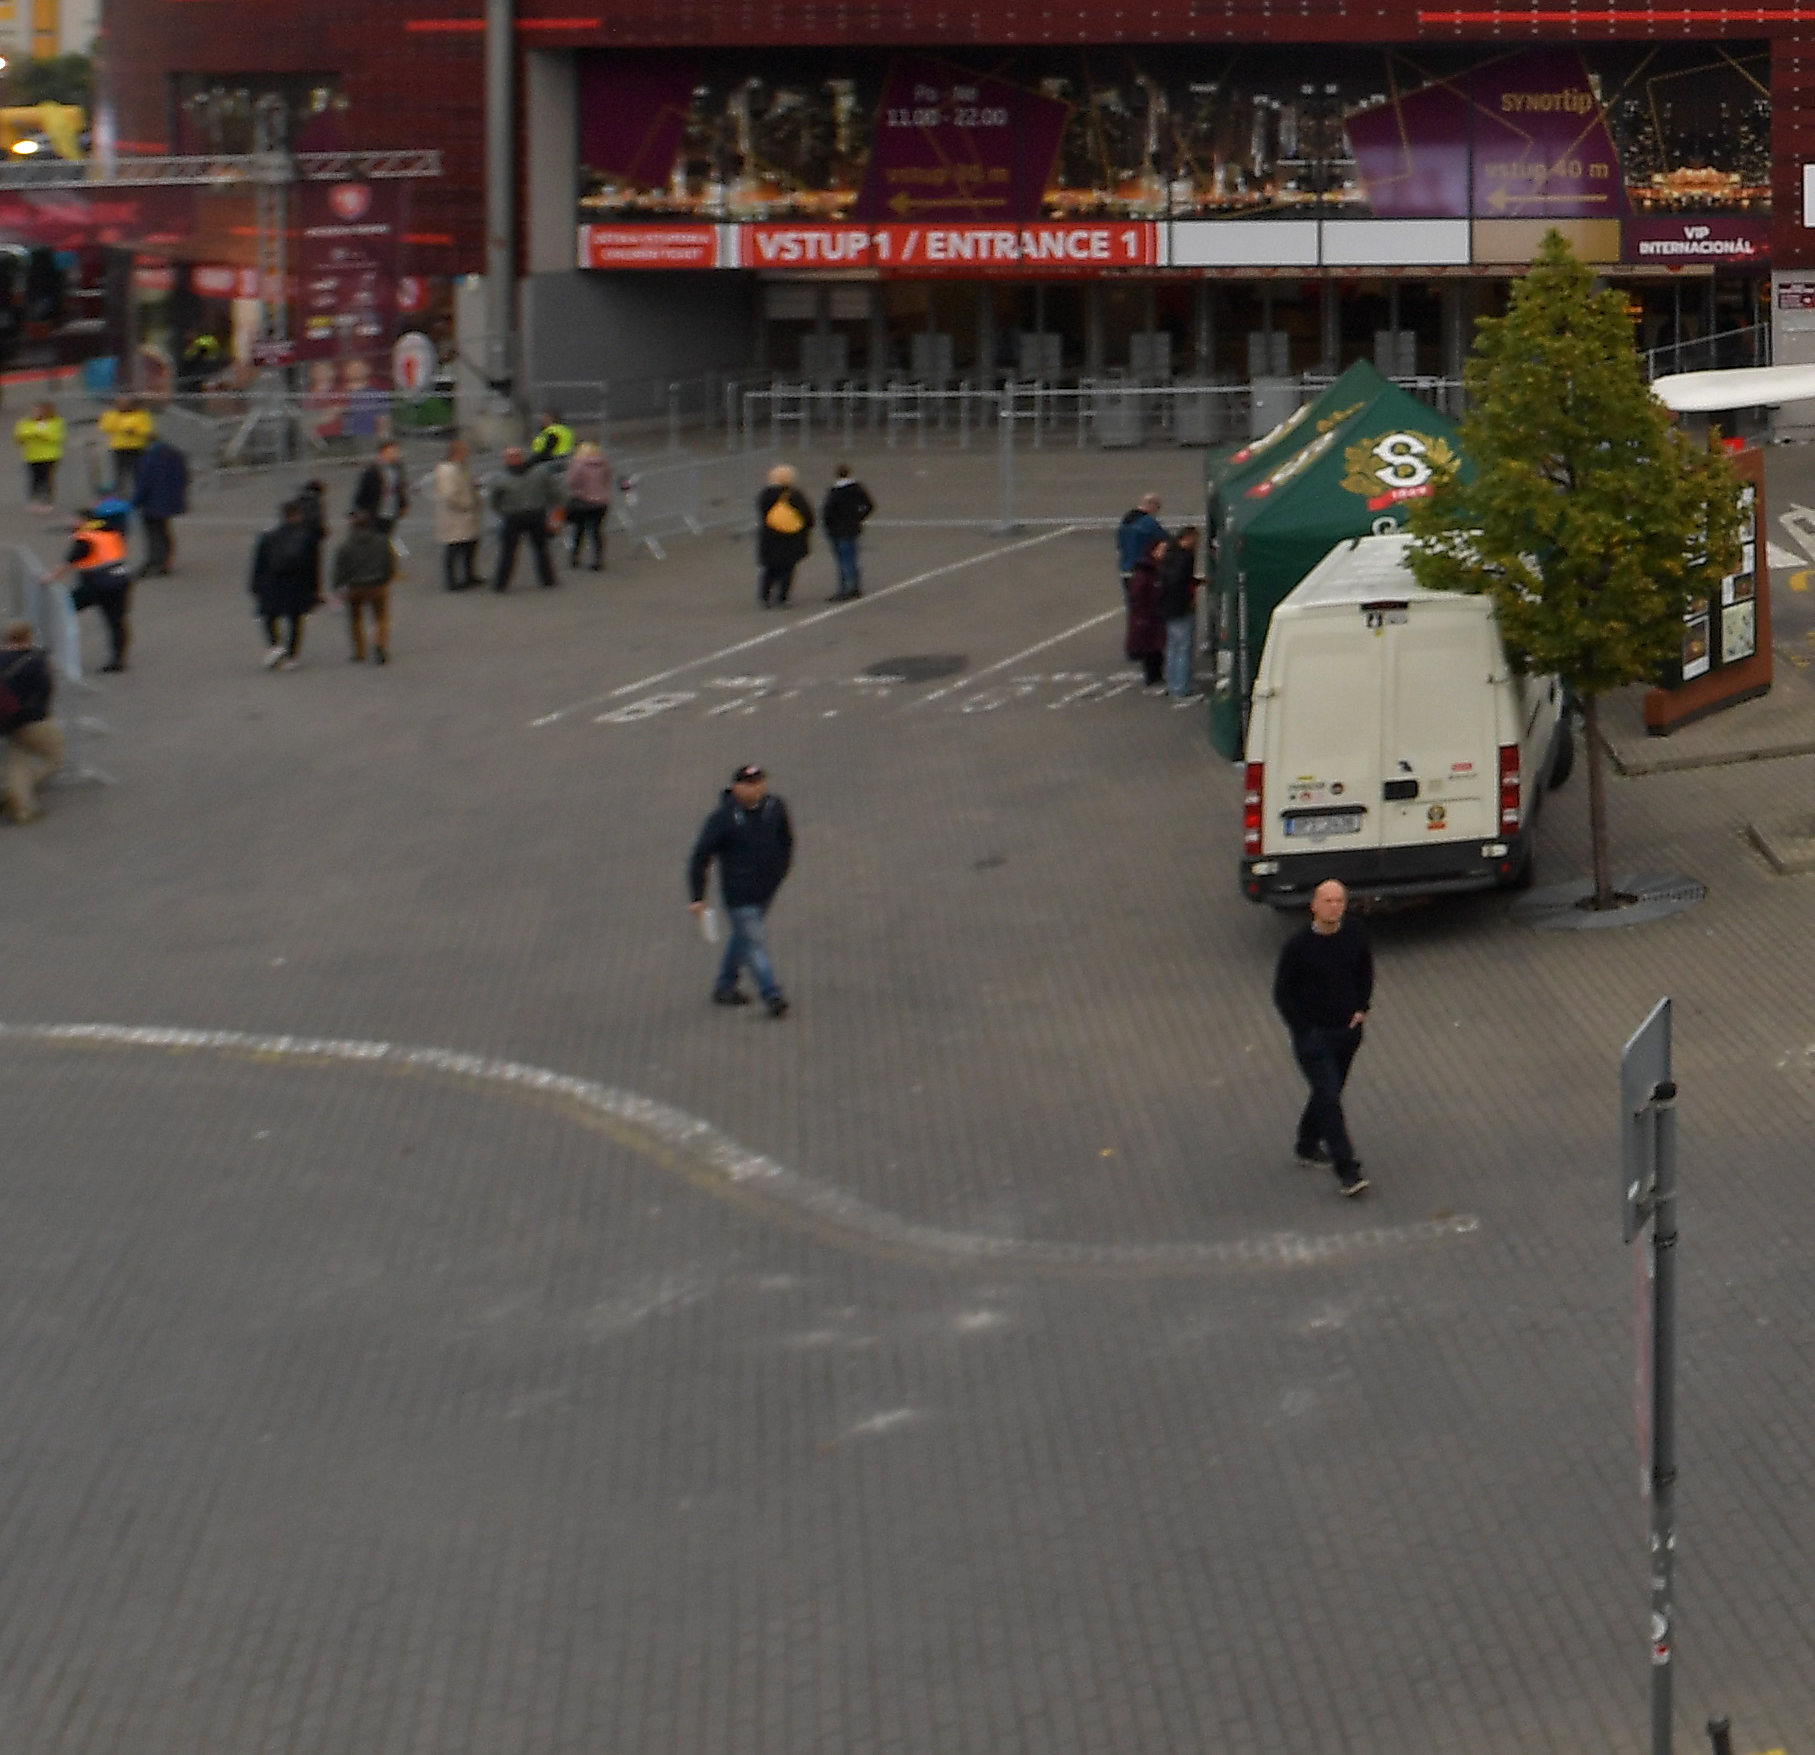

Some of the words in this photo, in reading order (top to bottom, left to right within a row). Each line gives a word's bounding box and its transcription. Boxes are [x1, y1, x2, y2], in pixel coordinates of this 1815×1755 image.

[1683, 226, 1711, 240] VIP
[756, 231, 870, 260] VSTUP
[872, 231, 891, 260] 1
[901, 230, 920, 260] /
[926, 231, 1111, 260] ENTRANCE
[1120, 231, 1138, 259] 1
[1638, 238, 1755, 255] INTERNACIONÁL
